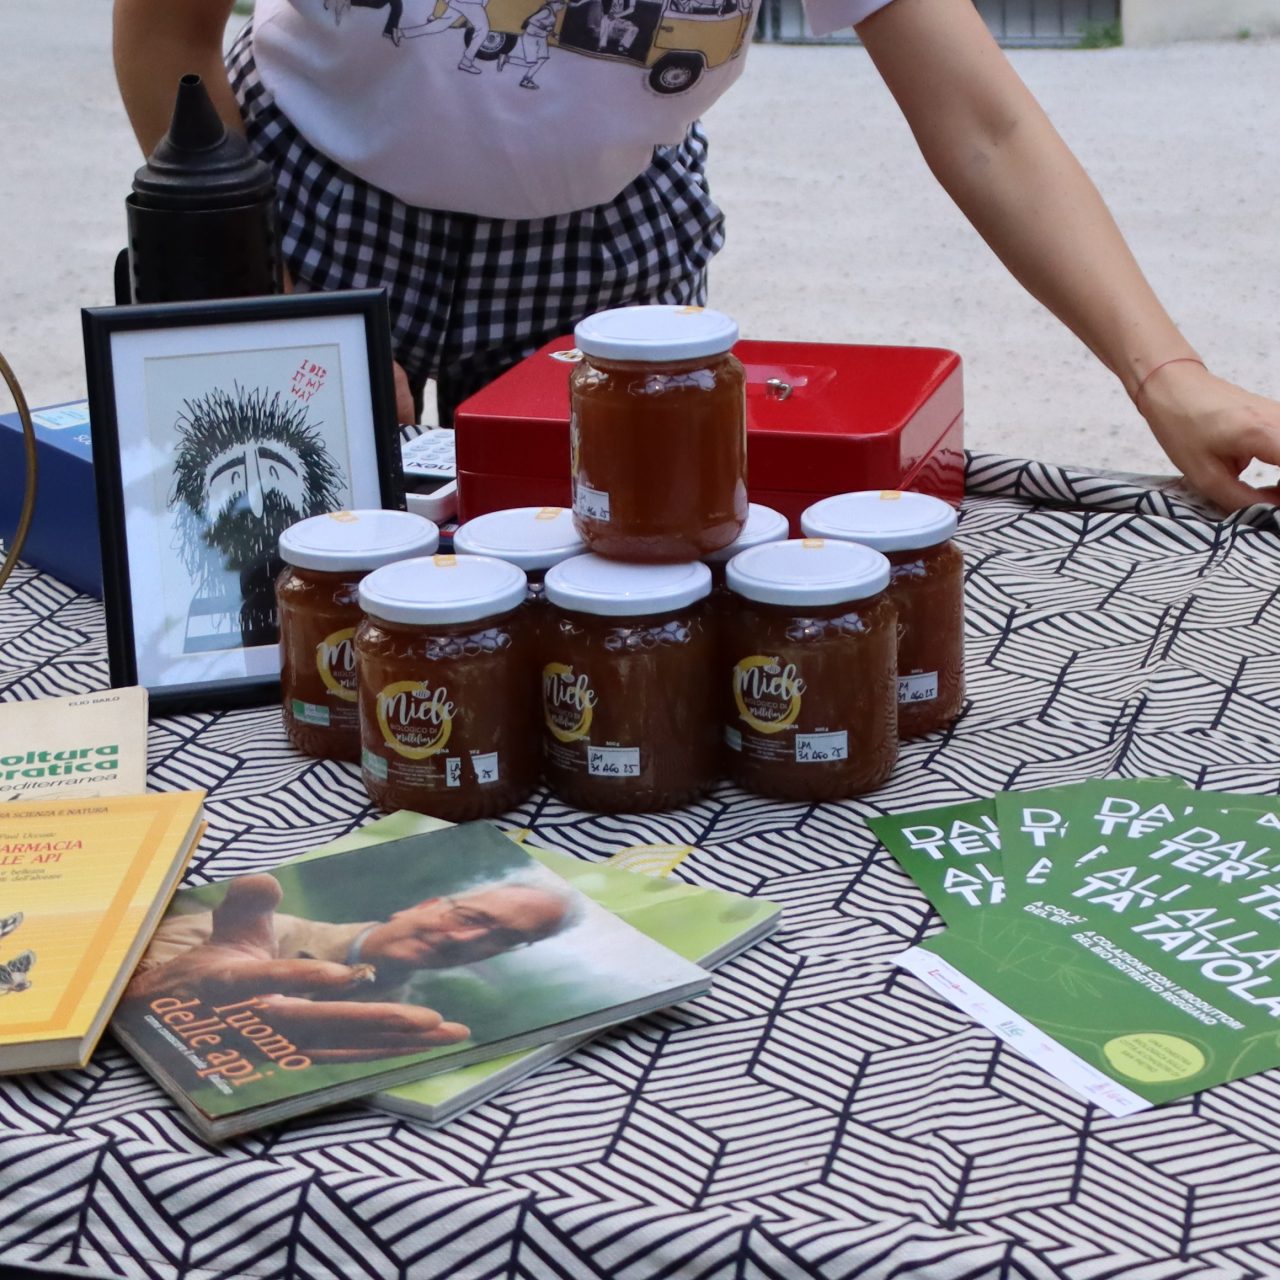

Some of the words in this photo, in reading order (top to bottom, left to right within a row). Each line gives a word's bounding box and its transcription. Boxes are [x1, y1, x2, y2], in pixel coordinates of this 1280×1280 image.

[300, 359, 309, 370] I
[309, 364, 327, 378] DID
[292, 370, 305, 382] IT
[305, 379, 325, 393] MY
[291, 384, 314, 402] WAY
[406, 461, 455, 470] nexi
[733, 663, 807, 700] Miele
[376, 687, 458, 725] Miele
[0, 745, 119, 766] oltura
[0, 759, 119, 780] ratica
[0, 839, 83, 854] ARMACIA
[31, 852, 63, 864] API
[1023, 905, 1049, 919] DEL
[1071, 933, 1094, 948] DEL
[1090, 945, 1113, 960] BIO
[1108, 956, 1164, 993] DISTRETTO
[1159, 991, 1218, 1026] REGGIANO
[1093, 936, 1152, 973] COLAZIONE
[1149, 969, 1174, 988] CON
[1174, 988, 1245, 1030] PRODUTTORI
[150, 997, 227, 1048] delle
[196, 1049, 275, 1087] api
[212, 997, 311, 1071] l'uomo
